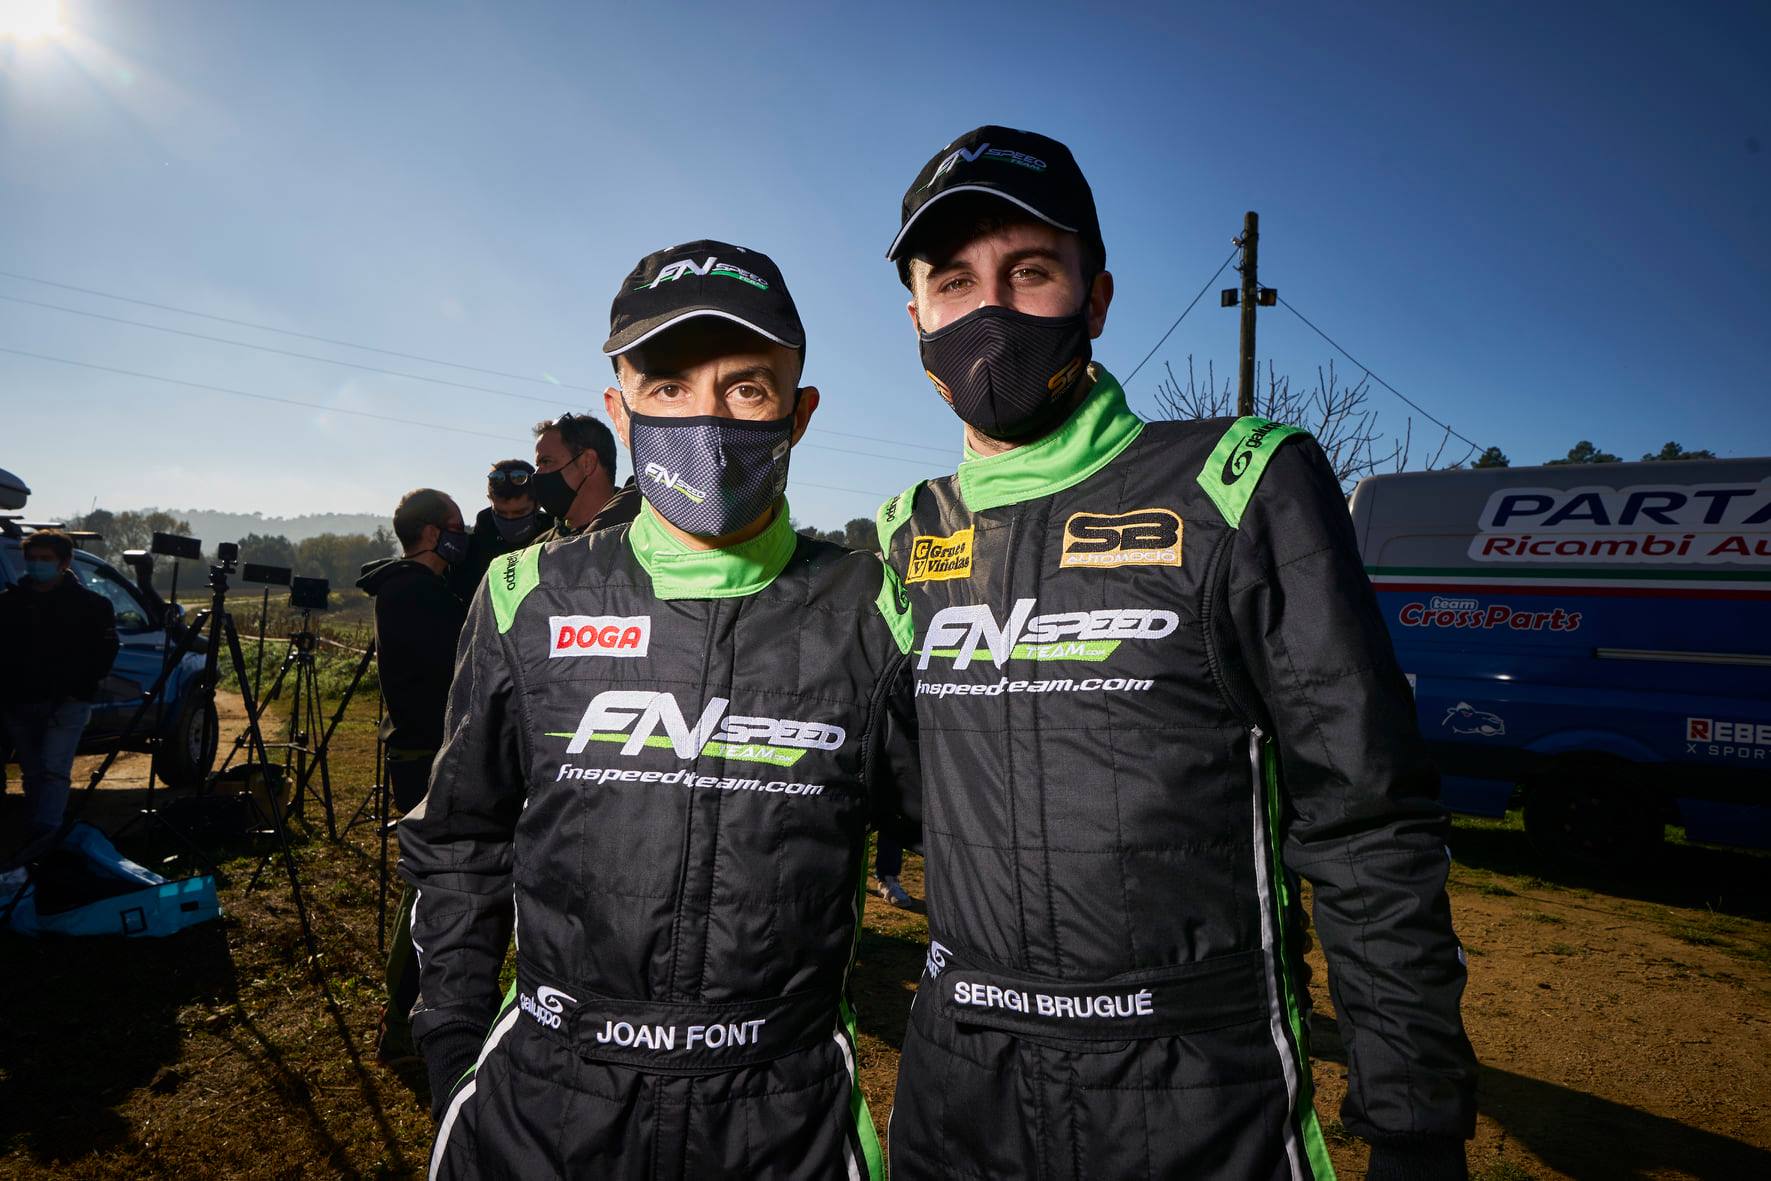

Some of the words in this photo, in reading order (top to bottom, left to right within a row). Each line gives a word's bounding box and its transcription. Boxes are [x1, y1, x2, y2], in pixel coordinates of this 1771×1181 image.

[1065, 511, 1180, 554] SB
[1482, 534, 1696, 556] Ricambi
[1400, 602, 1583, 632] CrossParts
[1432, 597, 1476, 610] team
[556, 625, 642, 649] DOGA
[1686, 743, 1697, 755] X
[1708, 745, 1771, 760] SPOR
[556, 763, 825, 797] fnspeedteam.com
[954, 981, 1030, 1014] SERGI
[1036, 989, 1154, 1019] BRUGUÉ
[596, 1021, 676, 1051] JOAN
[686, 1019, 766, 1050] FONT
